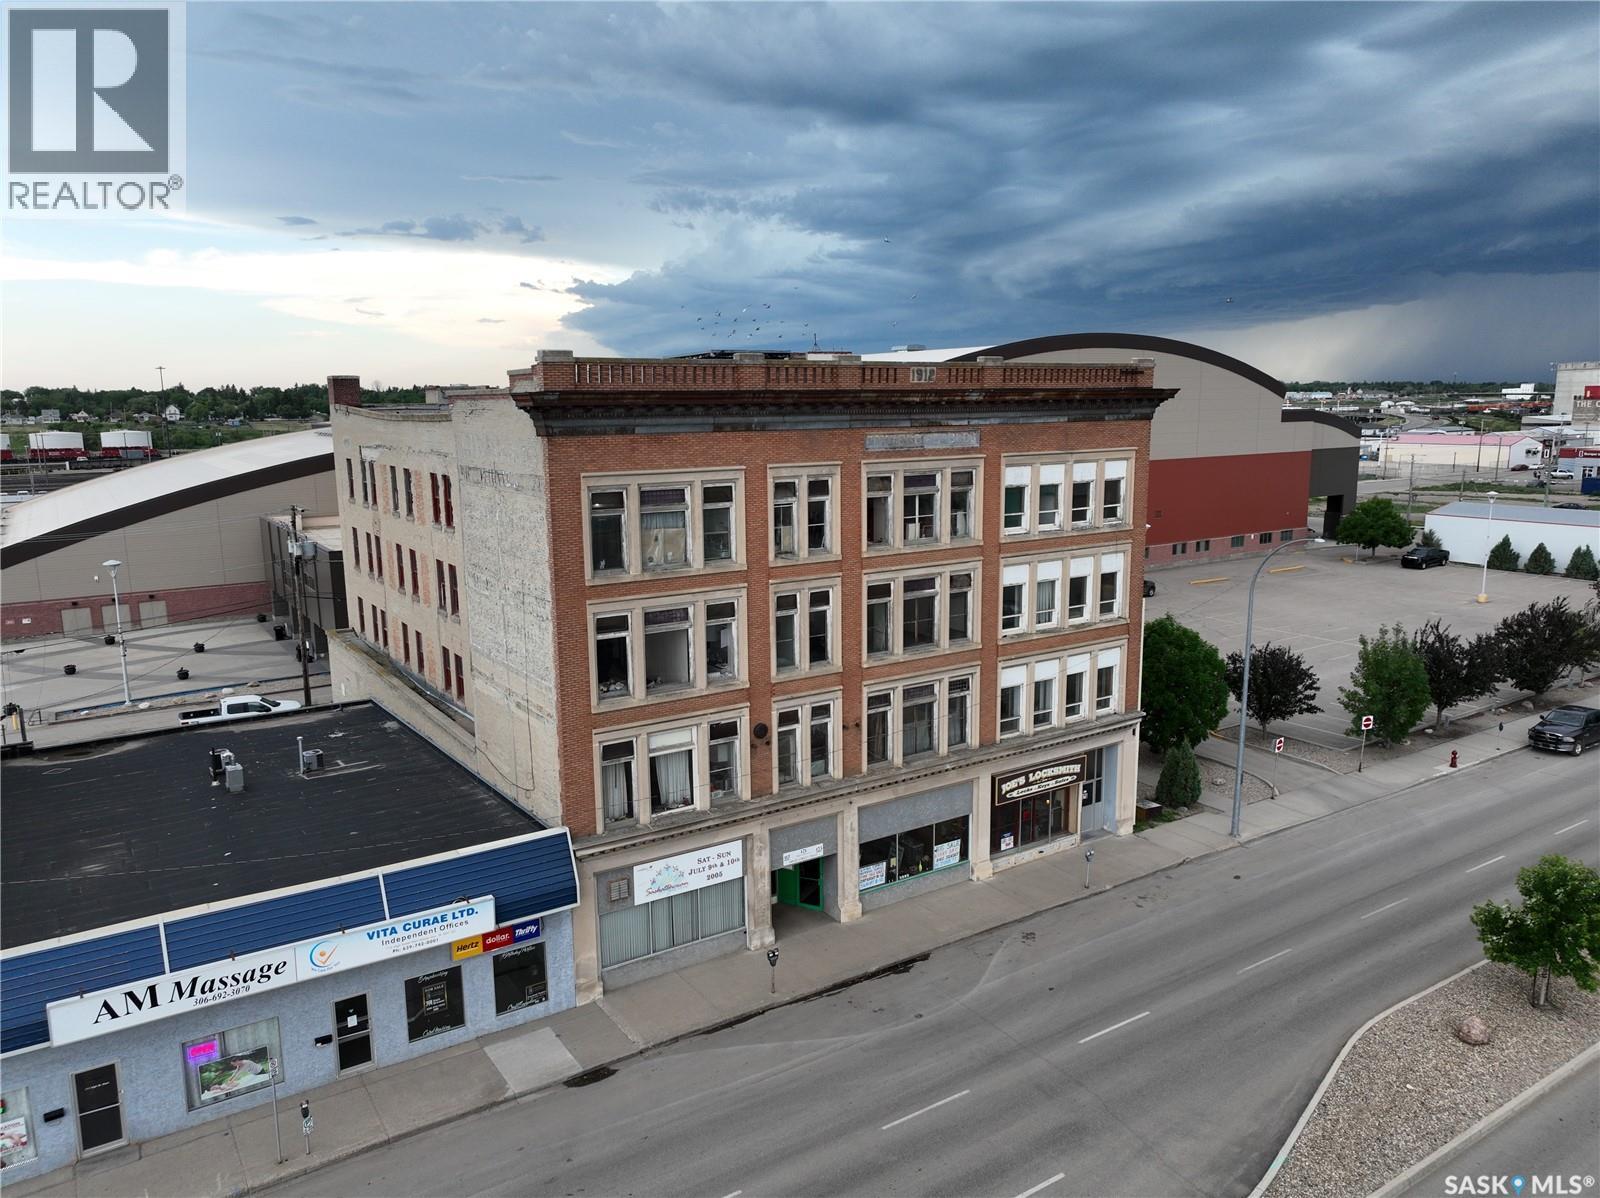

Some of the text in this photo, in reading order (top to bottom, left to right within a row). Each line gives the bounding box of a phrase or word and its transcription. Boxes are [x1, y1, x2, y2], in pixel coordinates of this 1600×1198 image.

[912, 367, 935, 382] 1912
[1576, 400, 1592, 408] THE
[1001, 764, 1081, 794] JOE'S LOCKSMITH
[697, 856, 710, 865] SAT
[717, 851, 731, 861] SUN
[688, 865, 706, 876] JULY
[706, 872, 723, 881] 2005
[367, 925, 398, 941] VITA
[402, 913, 448, 932] CURAE
[452, 907, 479, 921] LTD.
[381, 927, 437, 946] Independent
[440, 920, 469, 932] Offices
[456, 941, 480, 952] Hertz
[515, 925, 538, 937] Thrifty
[93, 960, 287, 1024] AM Massage
[193, 985, 251, 1007] 306-692-3070
